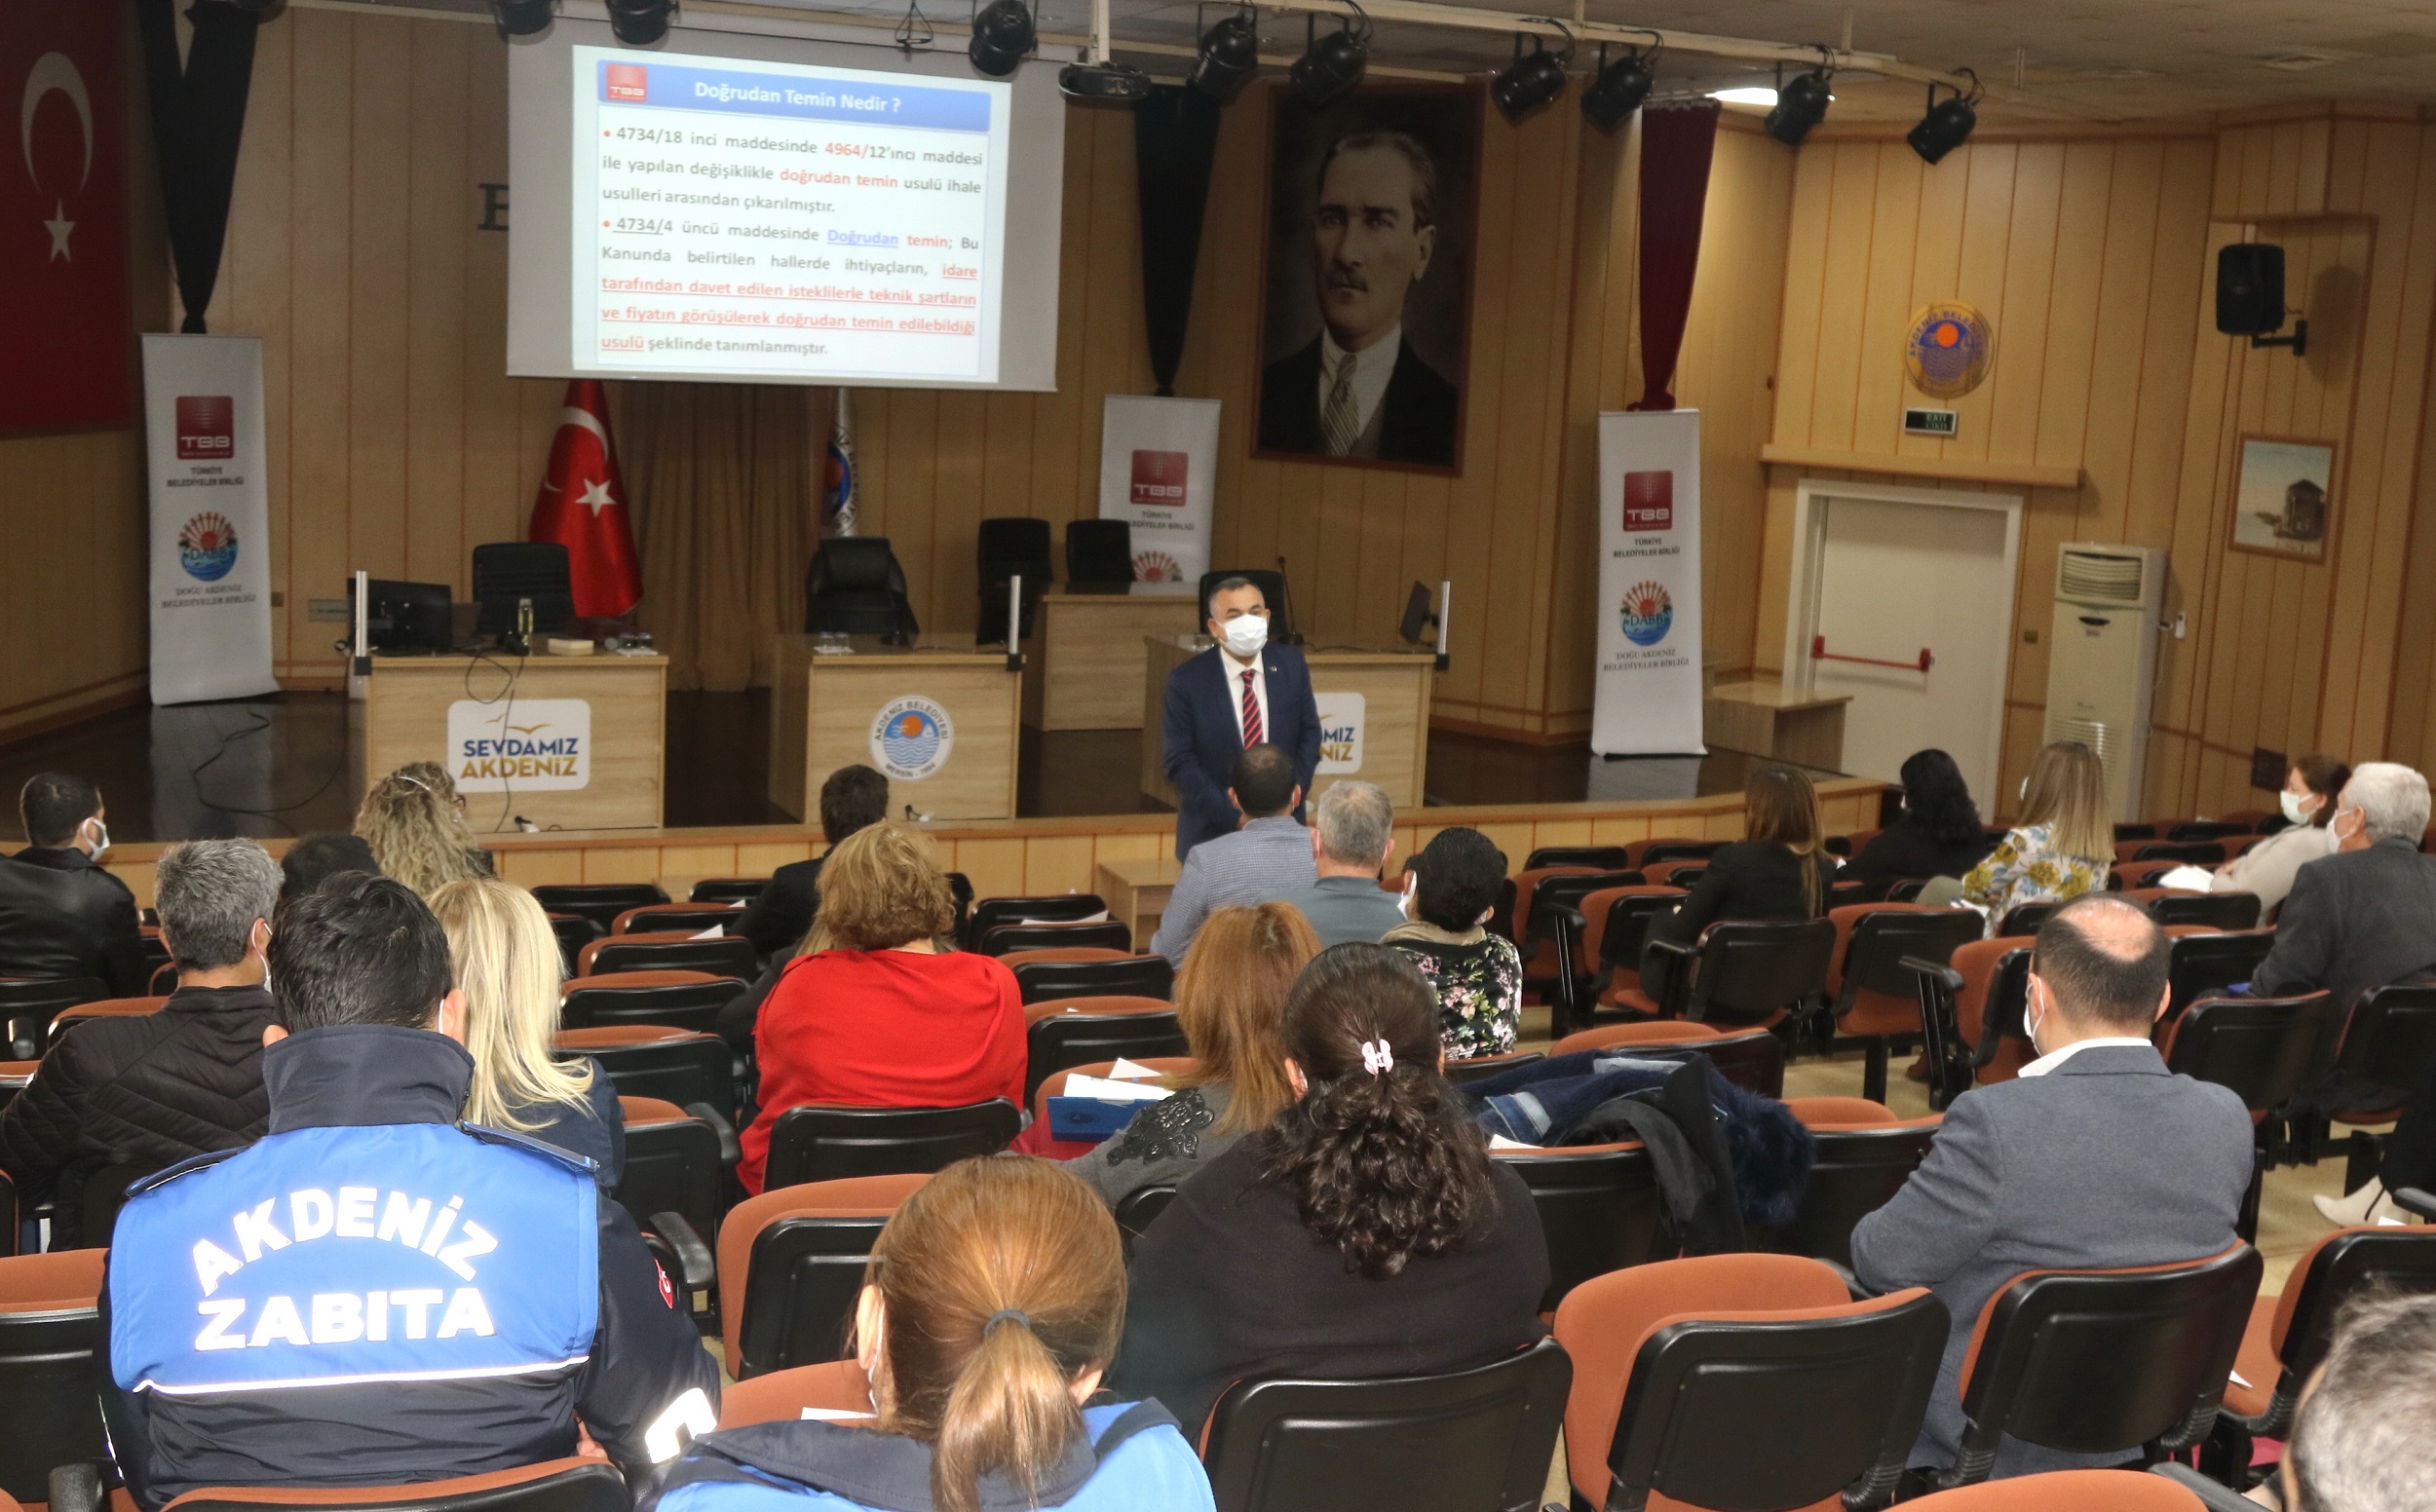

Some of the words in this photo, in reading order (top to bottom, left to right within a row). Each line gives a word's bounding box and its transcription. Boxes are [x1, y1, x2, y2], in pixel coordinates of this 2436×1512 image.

[610, 86, 645, 96] TBB
[695, 82, 780, 102] Doğrudan
[784, 90, 836, 107] Temin
[841, 94, 887, 111] Nedir
[893, 98, 901, 112] ?
[617, 127, 682, 144] 4734/18
[691, 132, 717, 146] inci
[725, 135, 818, 154] maddesinde
[924, 150, 983, 166] maddesi
[602, 155, 622, 170] ile
[628, 159, 684, 174] yapılan
[690, 162, 775, 180] değişiklikle
[780, 169, 851, 186] doğrudan
[856, 173, 898, 189] temin
[904, 177, 943, 192] usulü
[947, 178, 981, 194] ihale
[602, 187, 662, 203] usulleri
[665, 191, 740, 208] arasından
[743, 193, 835, 214] çıkarılmıştır.
[617, 217, 673, 235] 4734/4
[682, 221, 719, 236] üncü
[728, 223, 819, 242] maddesinde
[828, 229, 899, 246] Doğrudan
[906, 235, 953, 250] temin;
[961, 237, 979, 250] Bu
[601, 246, 672, 262] Kanunda
[688, 249, 756, 266] belirtilen
[771, 254, 831, 270] hallerde
[845, 257, 929, 277] ihtiyaçların,
[942, 264, 978, 279] idare
[601, 277, 683, 292] tarafından
[689, 279, 732, 294] davet
[737, 282, 783, 297] edilen
[788, 284, 864, 300] isteklilerle
[869, 286, 914, 302] teknik
[919, 289, 976, 306] şartların
[601, 308, 621, 320] ve
[626, 306, 676, 322] fiyatın
[682, 309, 771, 325] görüşülerek
[776, 312, 847, 328] doğrudan
[853, 316, 894, 331] temin
[899, 318, 975, 335] edilebildiği
[601, 336, 644, 350] usulü
[648, 337, 713, 353] şeklinde
[716, 339, 828, 357] tanımlanmıştır.
[180, 435, 231, 449] TBB
[1134, 483, 1183, 497] TBB
[1626, 508, 1670, 522] TBB
[463, 737, 579, 757] SEVDAMIZ
[191, 1185, 499, 1298] AKDENİZ
[194, 1286, 497, 1352] ZABITA
